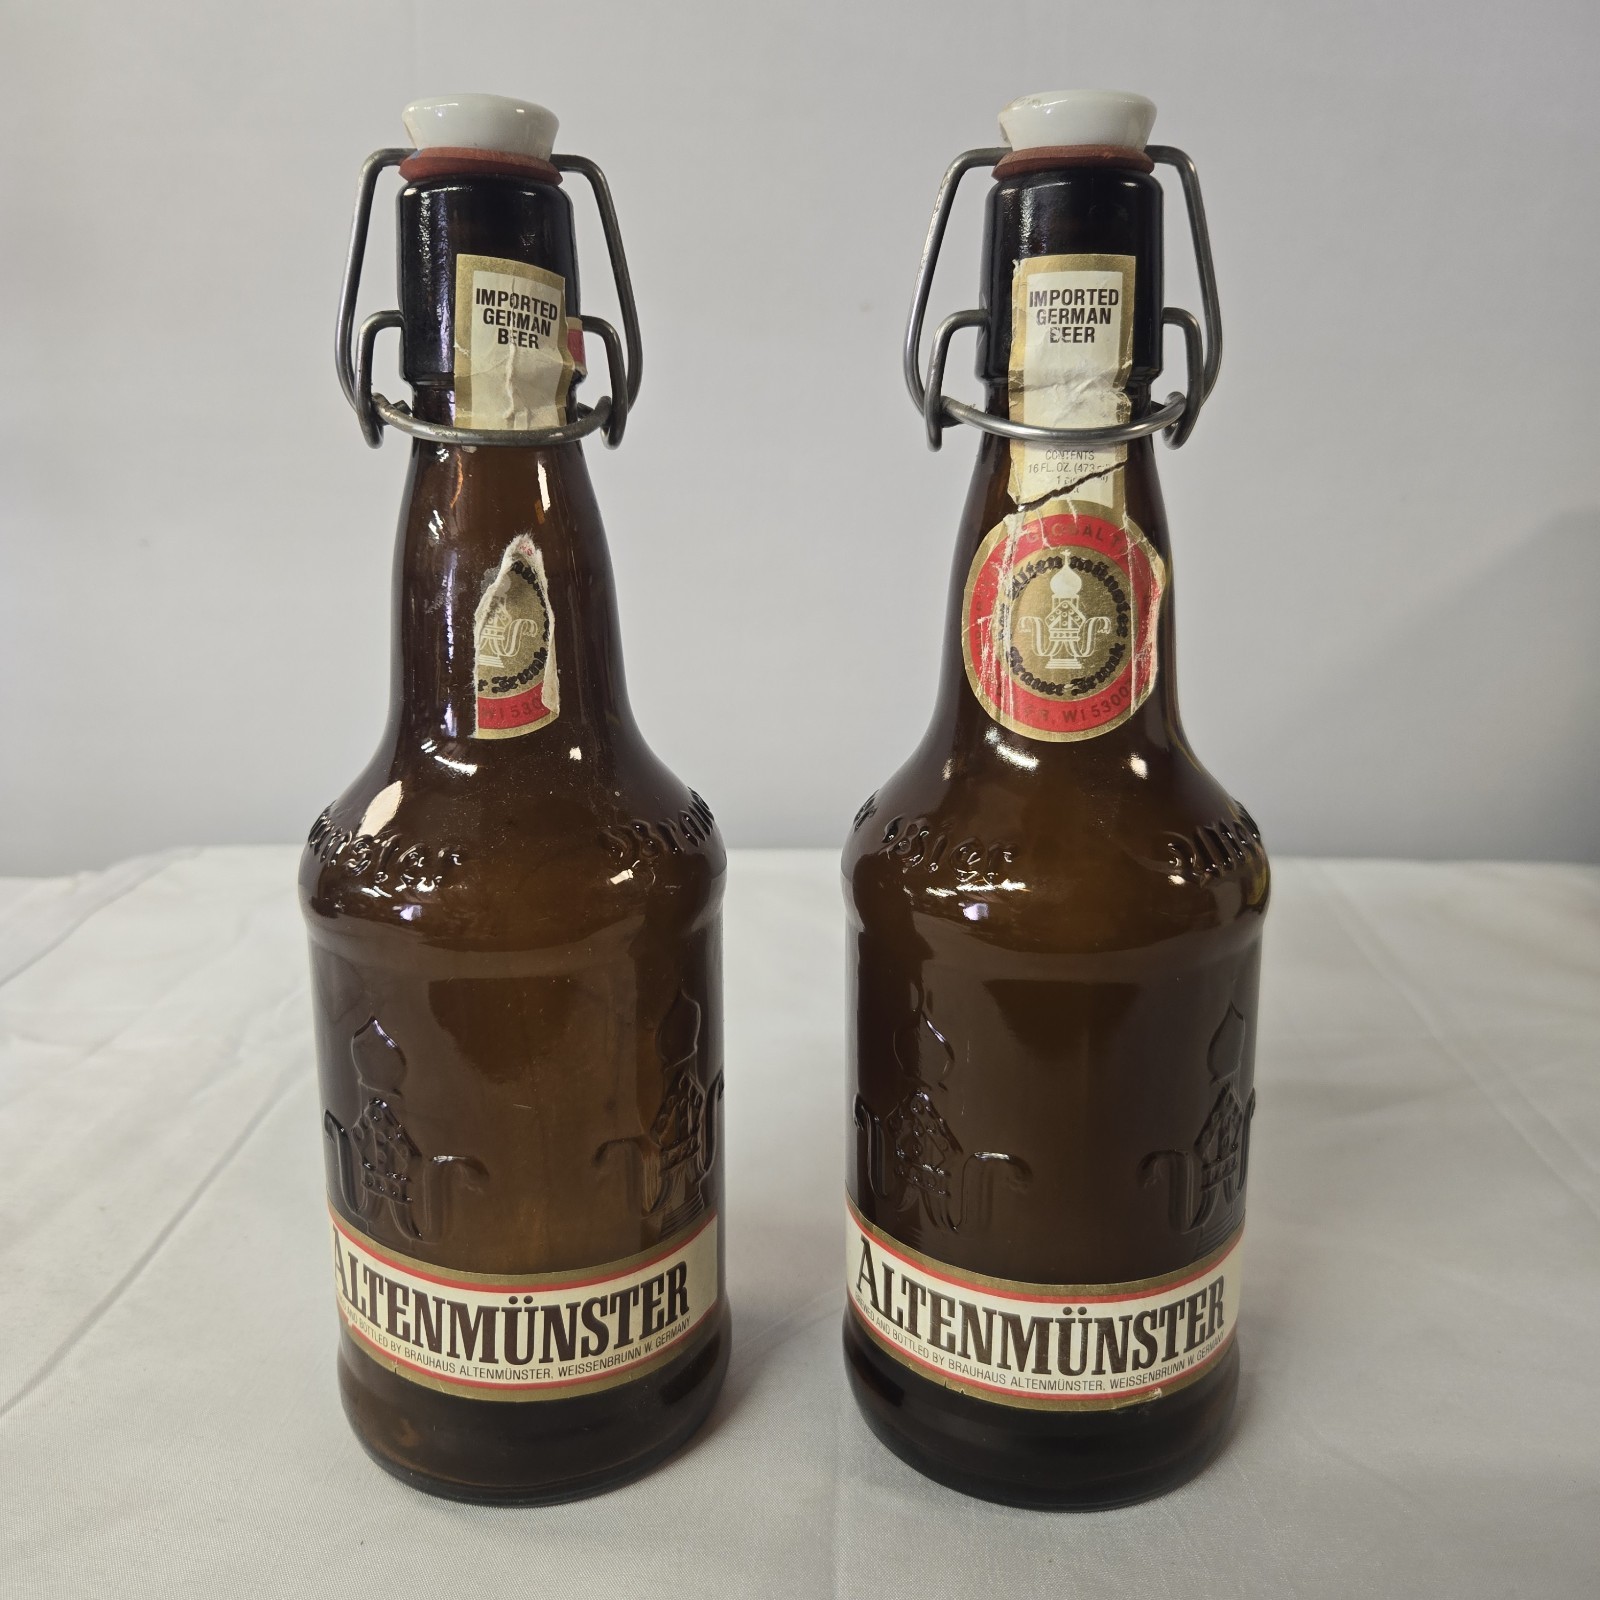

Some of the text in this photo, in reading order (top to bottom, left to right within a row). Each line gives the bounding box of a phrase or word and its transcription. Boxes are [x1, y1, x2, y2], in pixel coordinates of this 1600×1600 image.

[476, 288, 558, 321] IMPORTED
[1029, 288, 1119, 307] IMPORTED
[483, 308, 551, 337] GERMAN
[1036, 308, 1112, 325] GERMAN
[1028, 463, 1039, 473] 16
[1056, 462, 1072, 472] OZ.
[332, 1223, 690, 1367] ALTENMÜNSTER
[856, 1235, 1225, 1377] ALTENMÜNSTER
[360, 1320, 388, 1347] BOTTLED
[391, 1341, 402, 1353] BY
[405, 1348, 456, 1374] BRAUHAUS
[558, 1346, 642, 1378] WEISSENBRUNN
[655, 1315, 691, 1348] GERMANY
[876, 1317, 891, 1335] AND
[893, 1328, 930, 1359] BOTTLED
[933, 1352, 945, 1366] BY
[948, 1359, 1006, 1385] BRAUHAUS
[1109, 1360, 1185, 1390] WEISSENBRUNN
